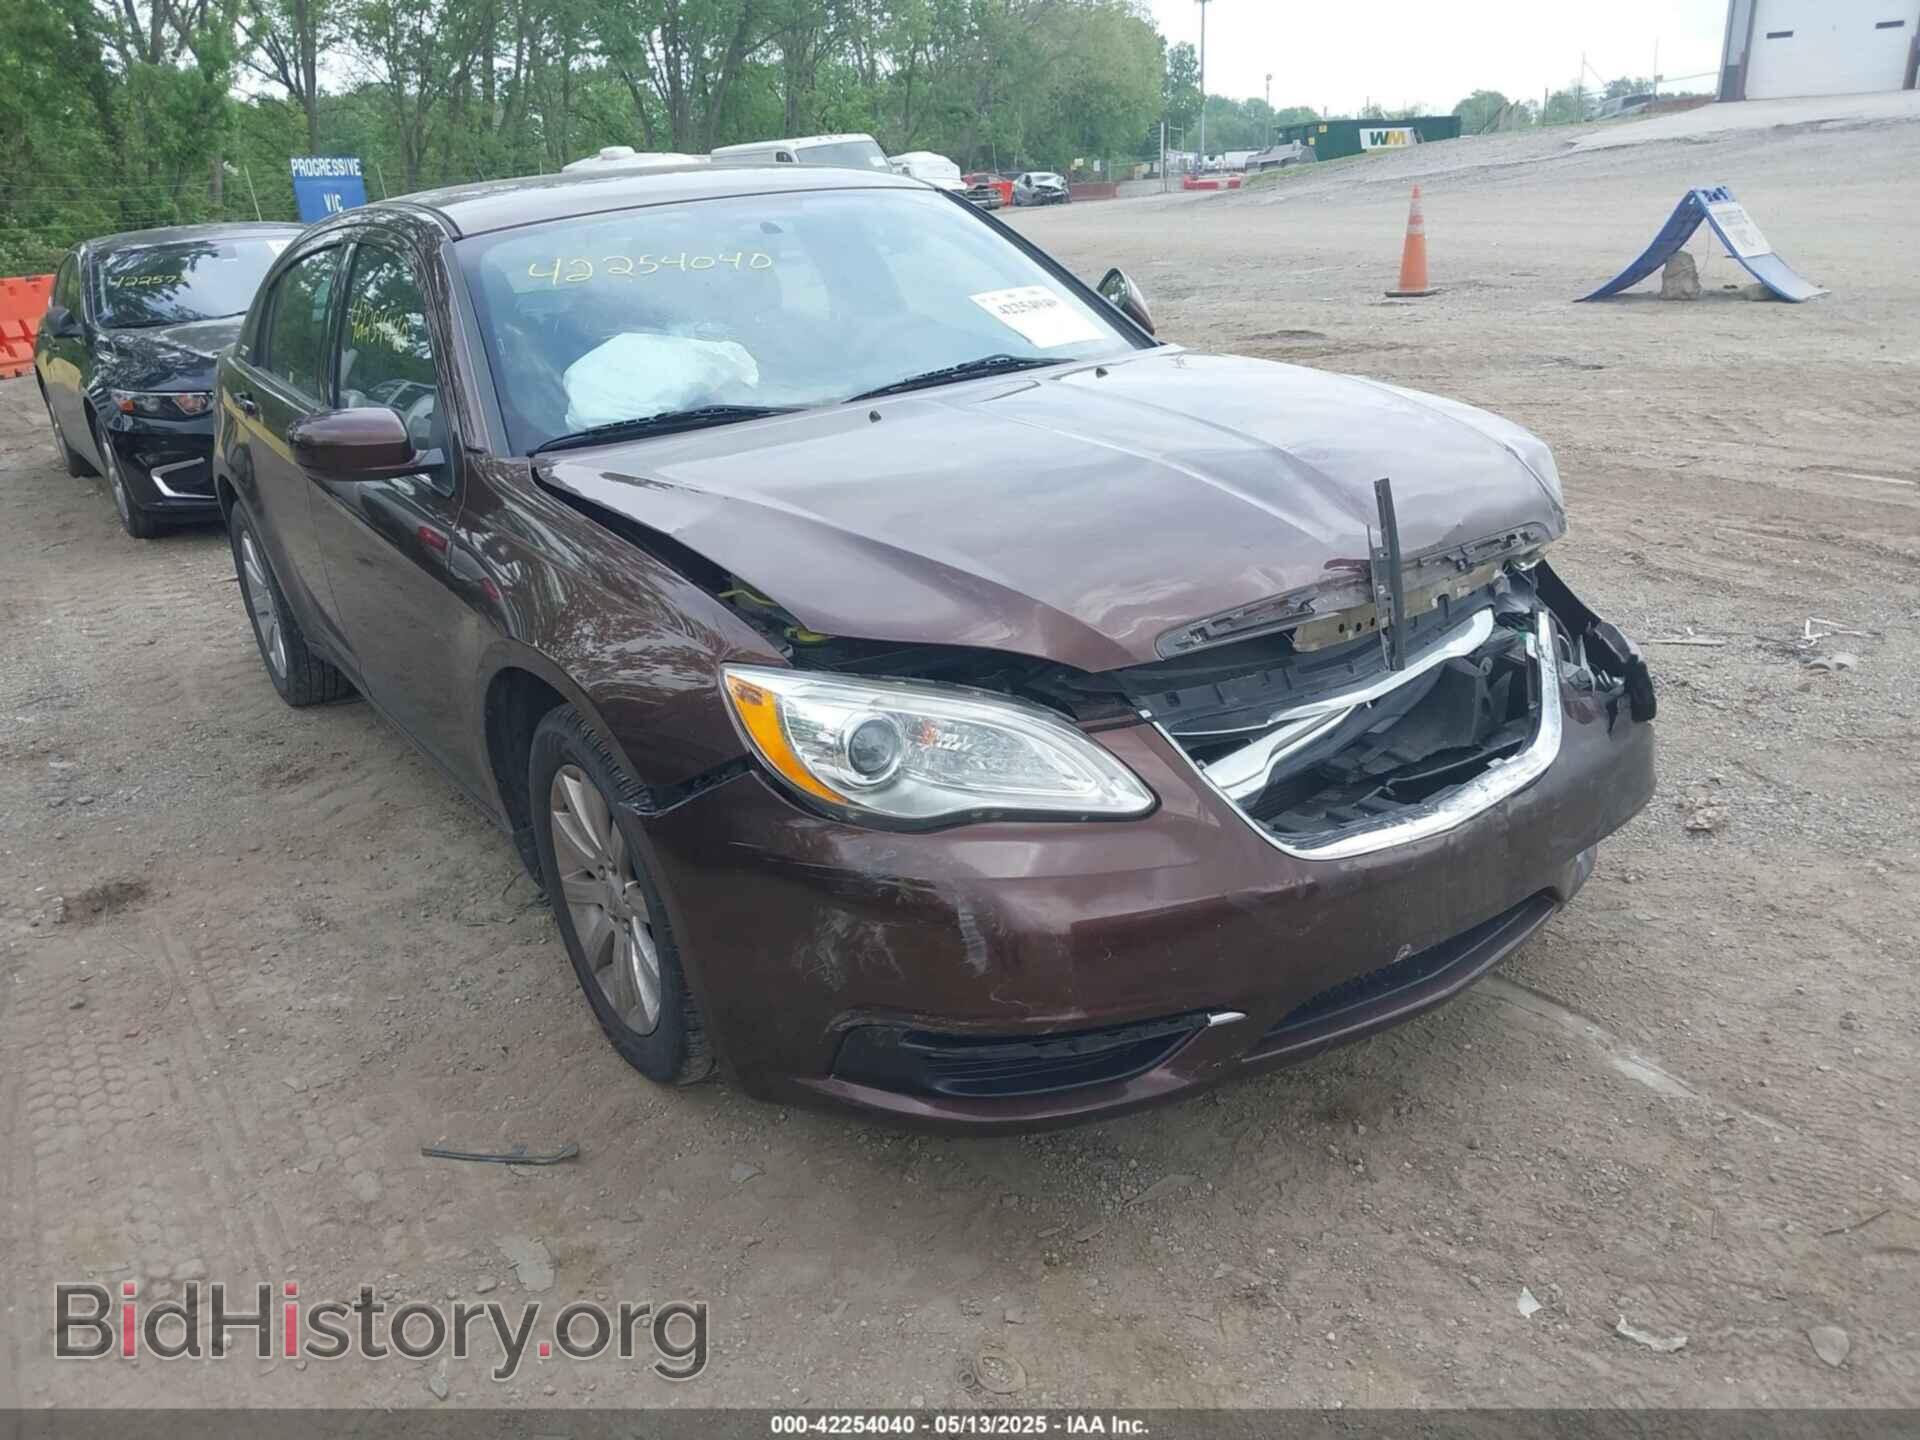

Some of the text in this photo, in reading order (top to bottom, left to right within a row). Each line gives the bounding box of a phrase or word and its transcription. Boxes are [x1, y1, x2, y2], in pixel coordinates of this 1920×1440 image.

[1369, 131, 1406, 146] WM
[290, 158, 362, 176] PROGRESSIVE
[527, 252, 773, 286] 42254040
